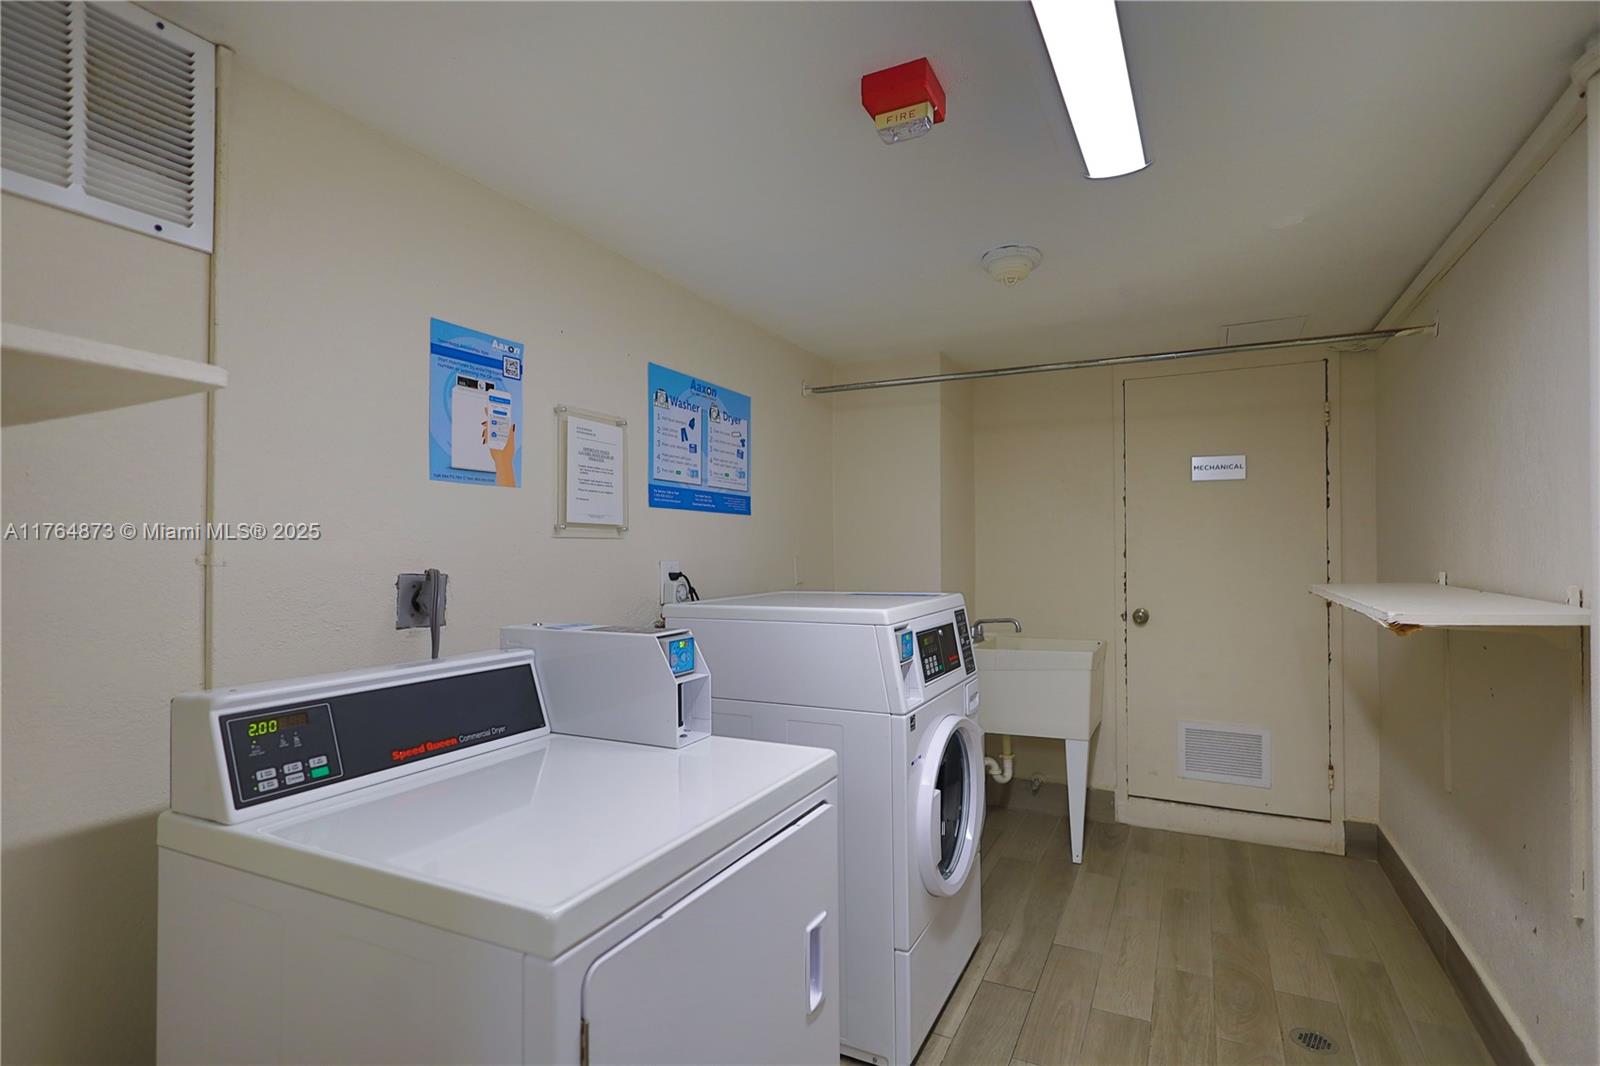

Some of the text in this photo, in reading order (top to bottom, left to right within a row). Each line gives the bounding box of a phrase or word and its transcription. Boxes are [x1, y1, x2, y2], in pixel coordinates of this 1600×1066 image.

[886, 109, 916, 124] FIRE
[492, 339, 520, 354] Aaxon
[690, 379, 717, 397] Aaxon
[669, 394, 700, 413] Washer
[722, 411, 741, 425] Dryer
[1193, 463, 1245, 471] MECHANICAL
[248, 719, 278, 737] 2.00
[391, 725, 506, 761] Speed Queen Commercial Dryer
